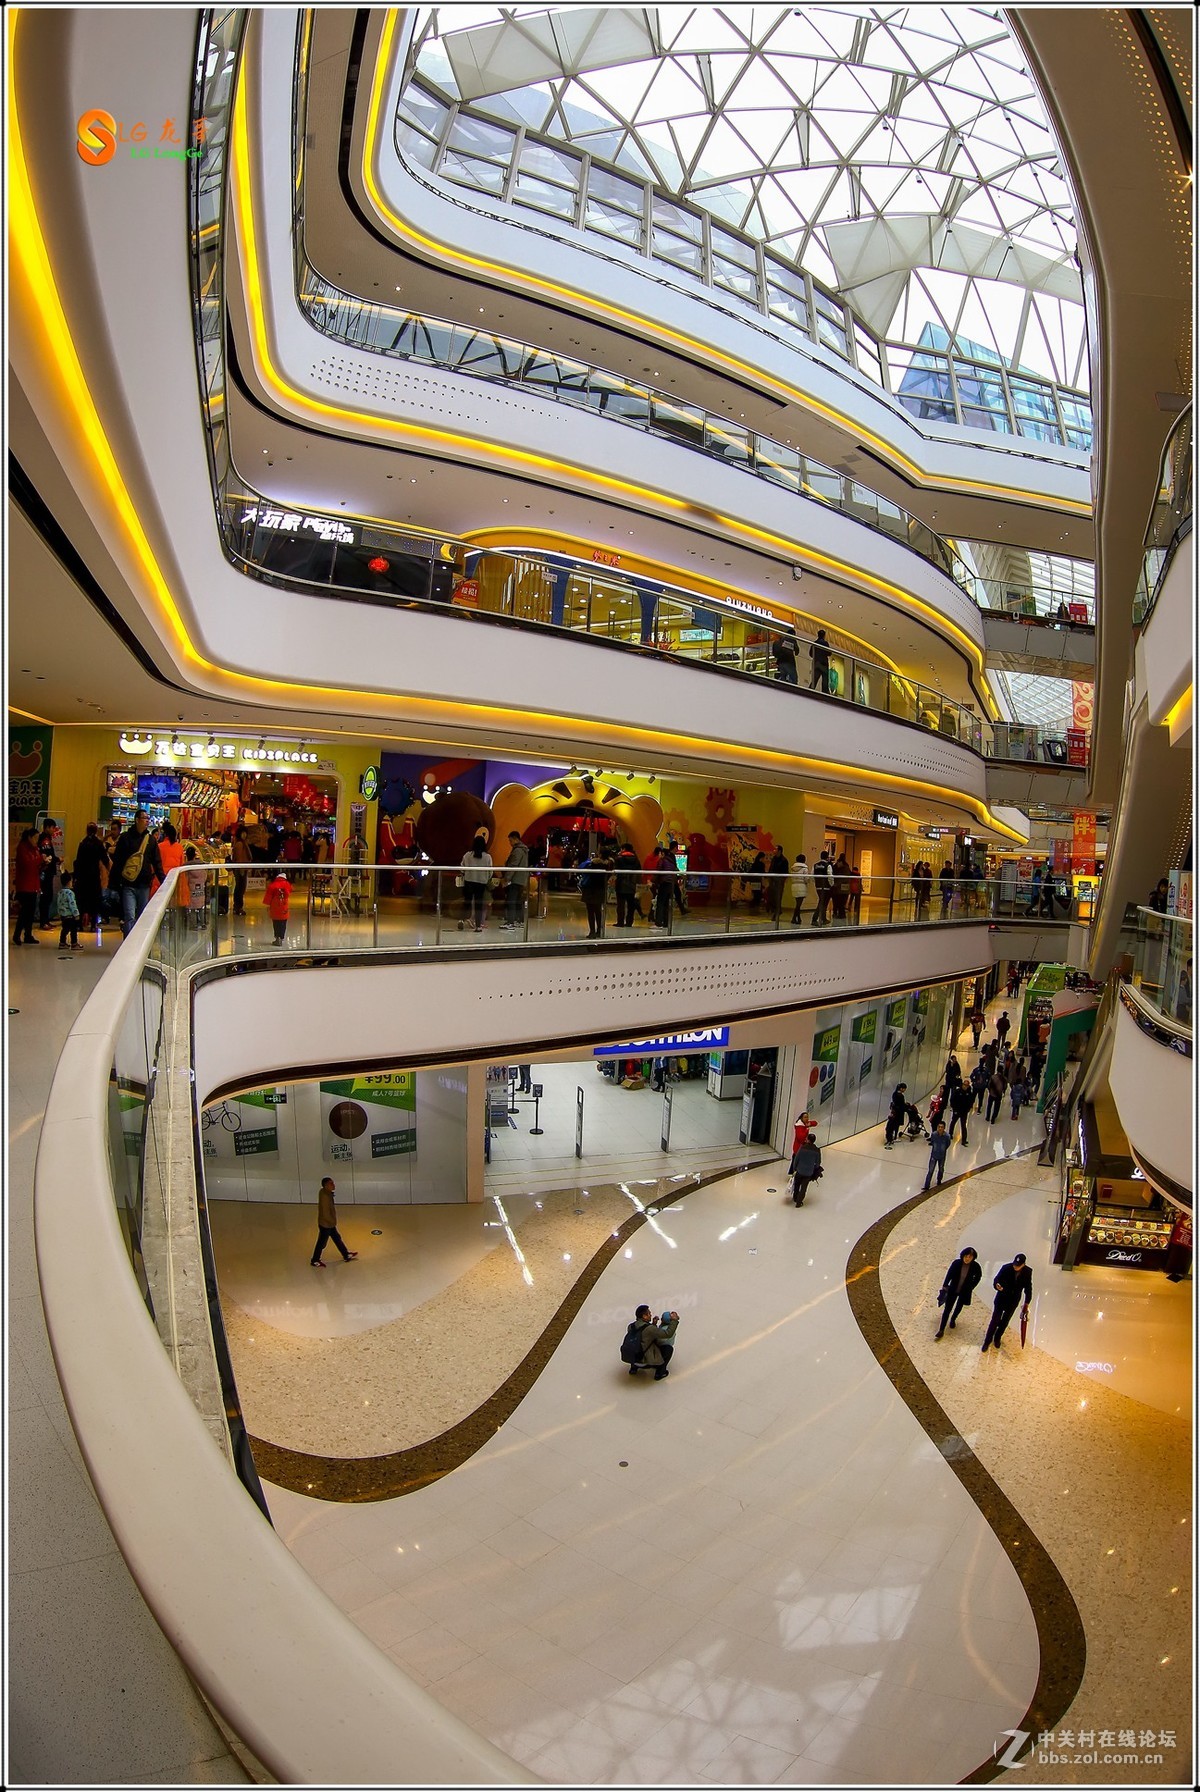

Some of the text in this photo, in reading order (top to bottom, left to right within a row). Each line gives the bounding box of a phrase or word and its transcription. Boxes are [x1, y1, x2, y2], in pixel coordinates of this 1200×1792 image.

[240, 508, 303, 532] 大玩家
[154, 739, 237, 760] 万达宝贝王
